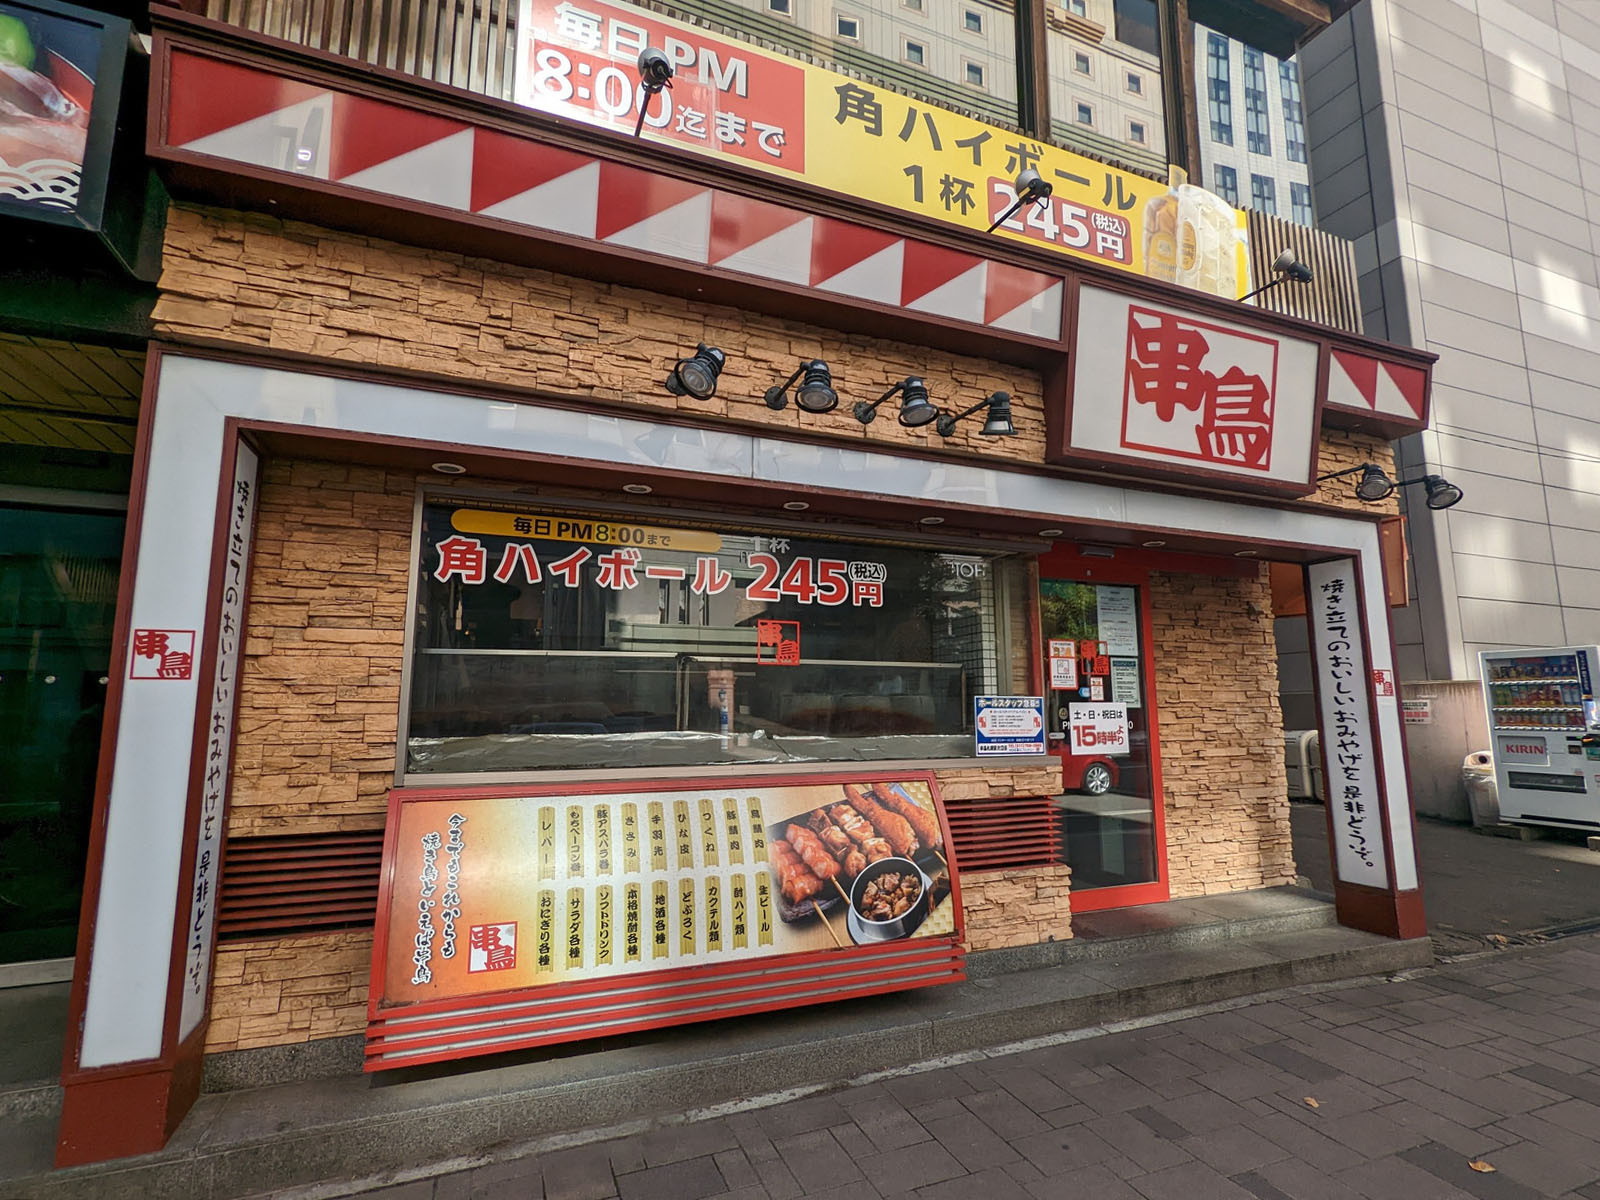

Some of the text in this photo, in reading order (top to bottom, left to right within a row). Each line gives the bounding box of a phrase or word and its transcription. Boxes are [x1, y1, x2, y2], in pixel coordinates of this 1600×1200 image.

[834, 82, 1136, 211] 角ハイボール
[1129, 315, 1271, 466] 串鳥
[434, 535, 732, 595] 角ハイボール
[133, 631, 192, 679] 串鳥
[1505, 743, 1545, 755] KIRIN
[541, 821, 552, 865] レバー
[625, 816, 637, 858] ささみ
[651, 814, 664, 857] 手羽先
[702, 812, 715, 852] つくね
[568, 898, 581, 959] サラダ各種
[599, 891, 610, 959] ソフトドリンク
[681, 891, 693, 941] どぶろく
[708, 886, 720, 942] カクテル類
[733, 887, 746, 936] 酎ハイ類
[758, 885, 771, 933] 生ビール
